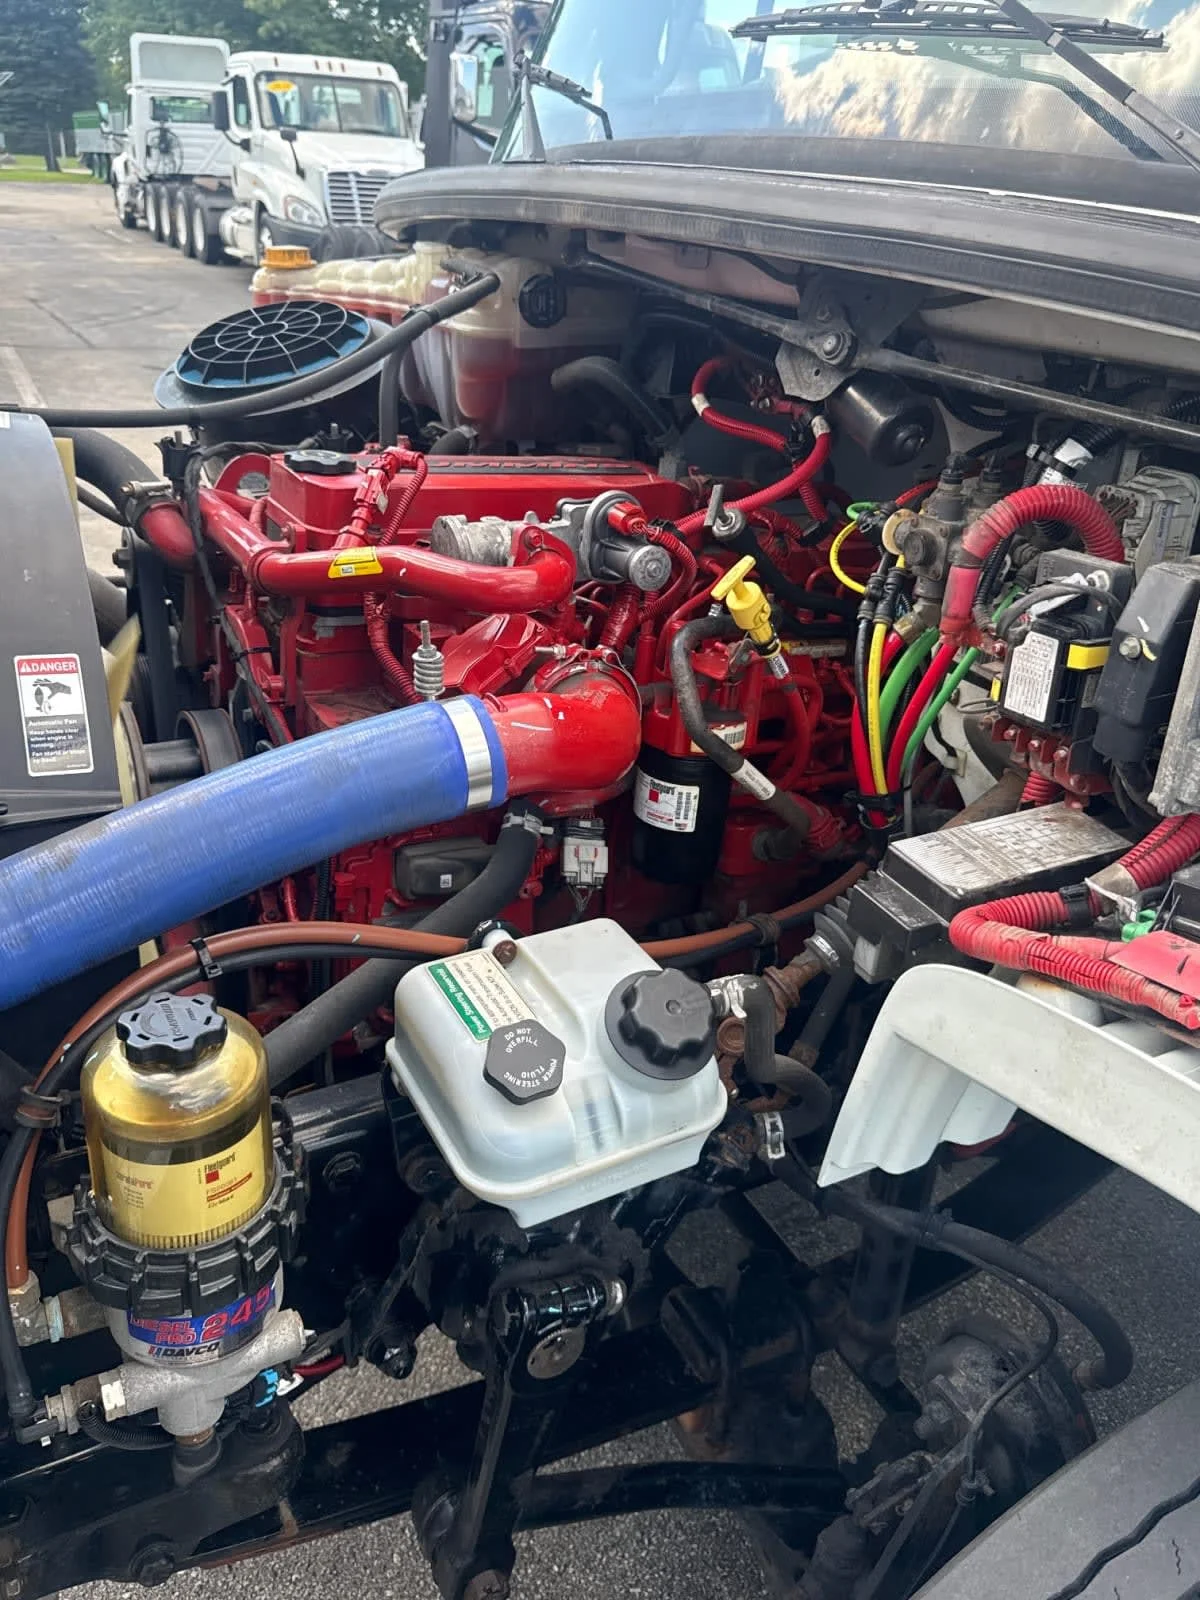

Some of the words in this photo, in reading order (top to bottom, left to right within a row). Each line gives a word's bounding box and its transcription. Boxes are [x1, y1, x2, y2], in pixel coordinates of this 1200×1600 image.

[31, 662, 77, 673] DANGER
[455, 991, 474, 1016] Steering
[470, 1015, 487, 1034] Power
[504, 1031, 515, 1041] DO
[505, 1036, 538, 1053] OVERFILL
[521, 1065, 545, 1079] FLUID
[541, 1058, 558, 1082] POWER
[503, 1072, 541, 1088] STEERING
[130, 1314, 195, 1333] DIESEL
[156, 1331, 197, 1345] PRO
[161, 1341, 220, 1357] DAVCO
